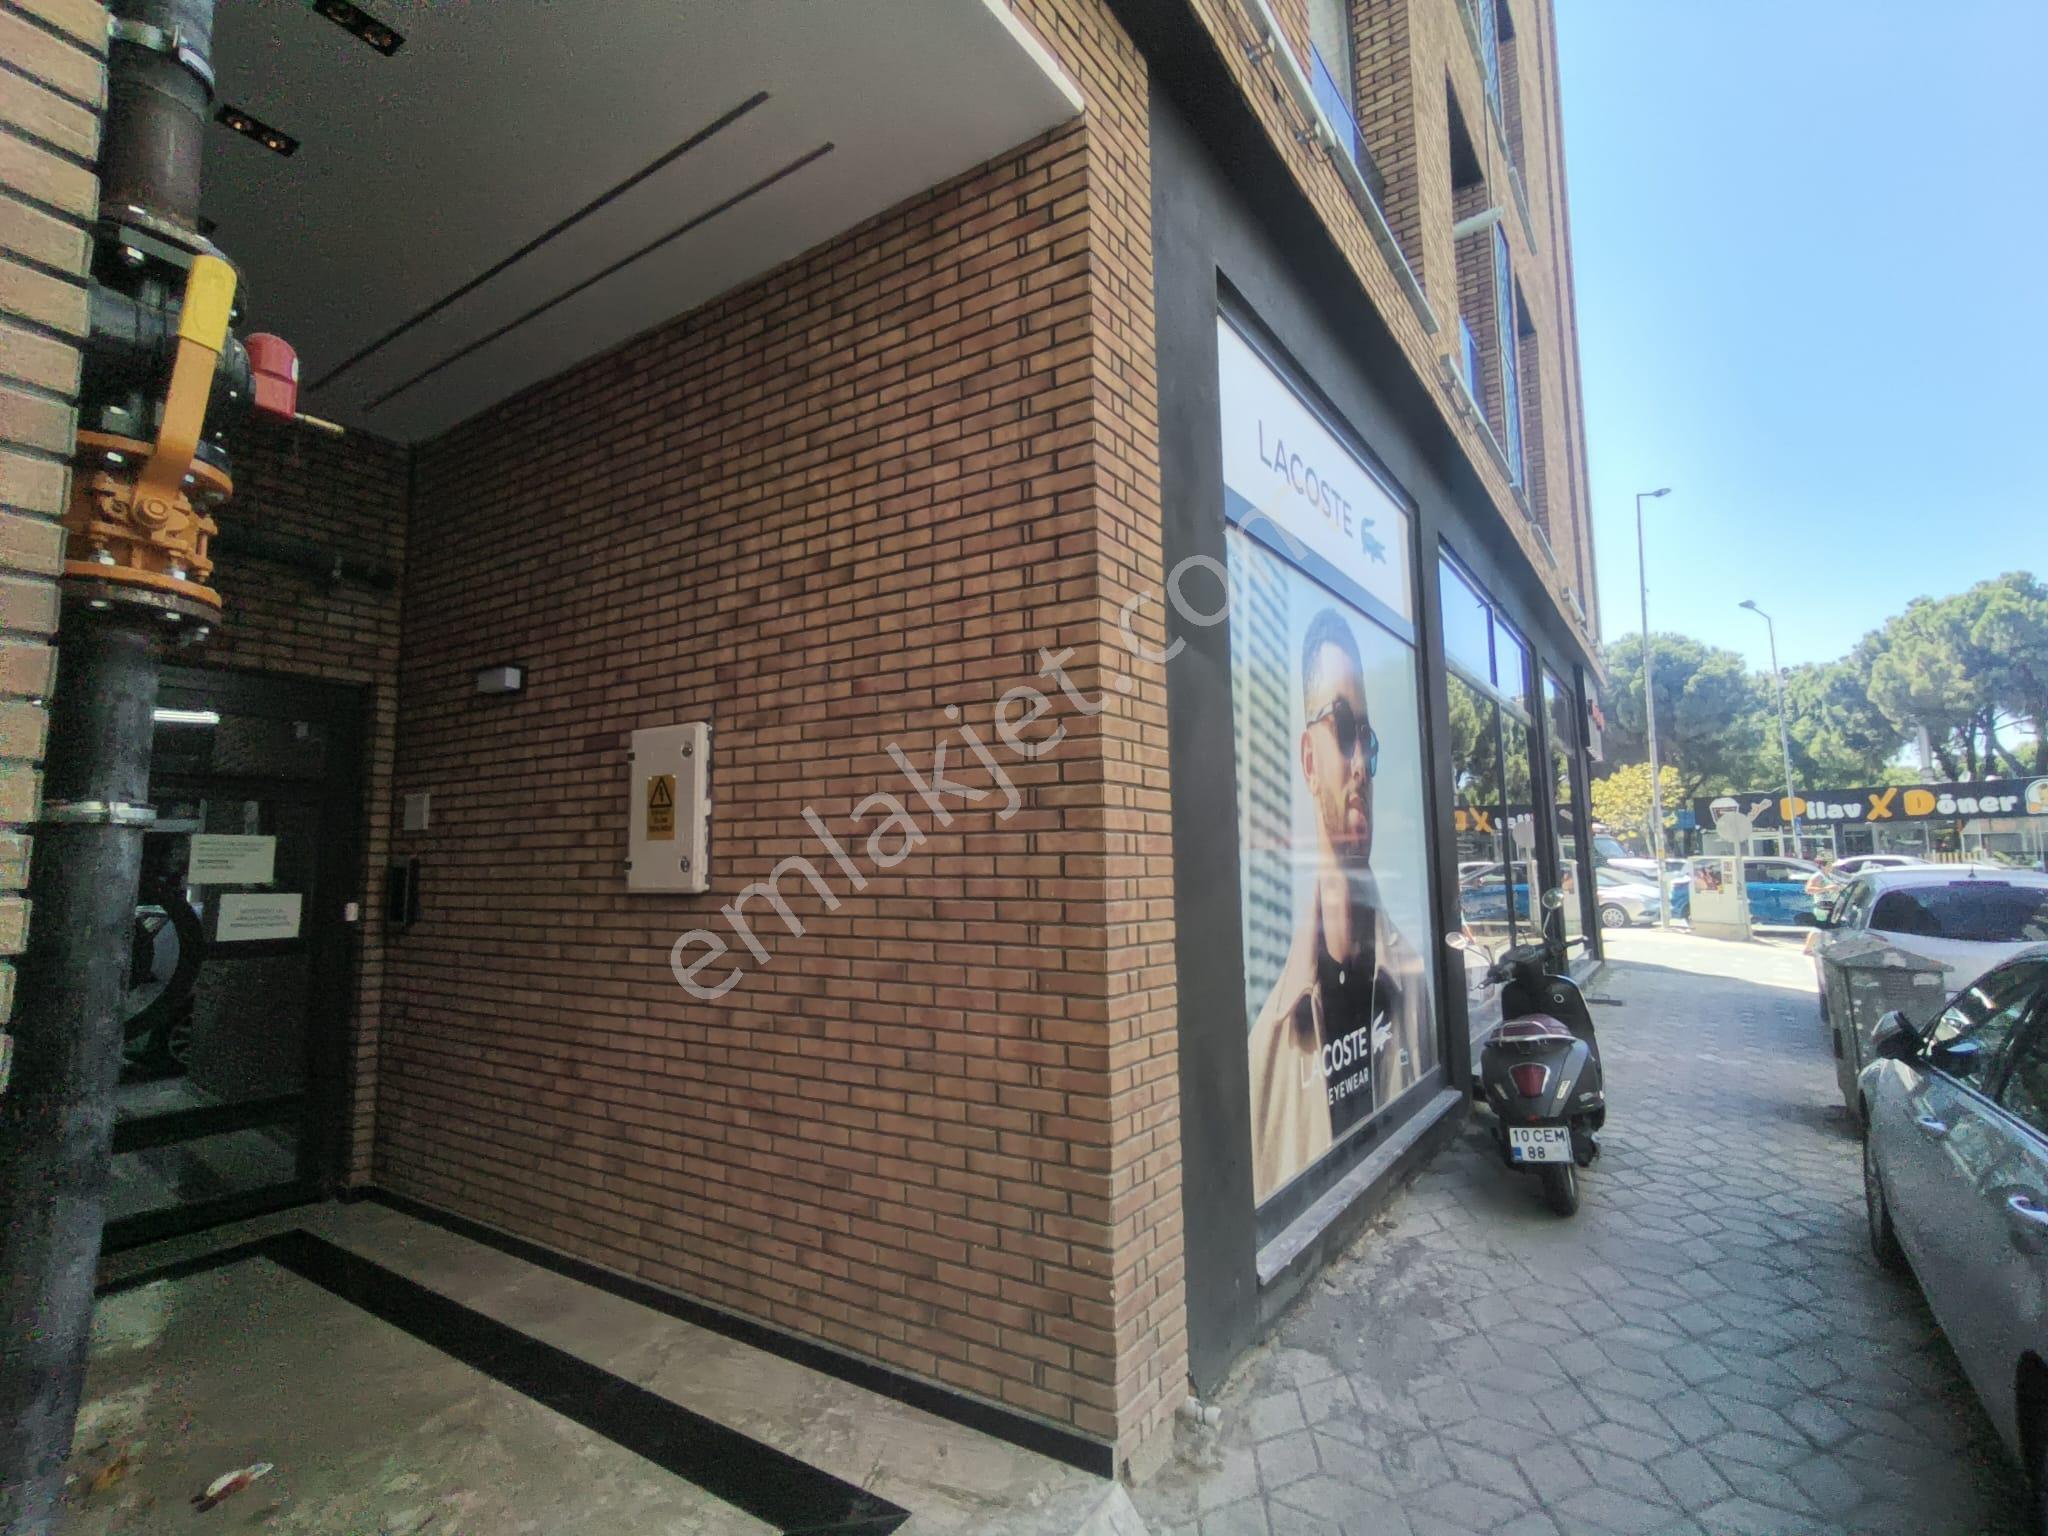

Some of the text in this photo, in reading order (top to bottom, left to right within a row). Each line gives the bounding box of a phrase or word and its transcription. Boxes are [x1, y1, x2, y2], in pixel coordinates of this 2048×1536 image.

[1258, 419, 1354, 538] LACOSTE
[1866, 787, 1898, 821] X
[1904, 788, 2018, 816] Döner
[1328, 1067, 1369, 1106] EYEWEAR
[1513, 1130, 1566, 1143] 10 CEM
[1527, 1146, 1546, 1159] 88
